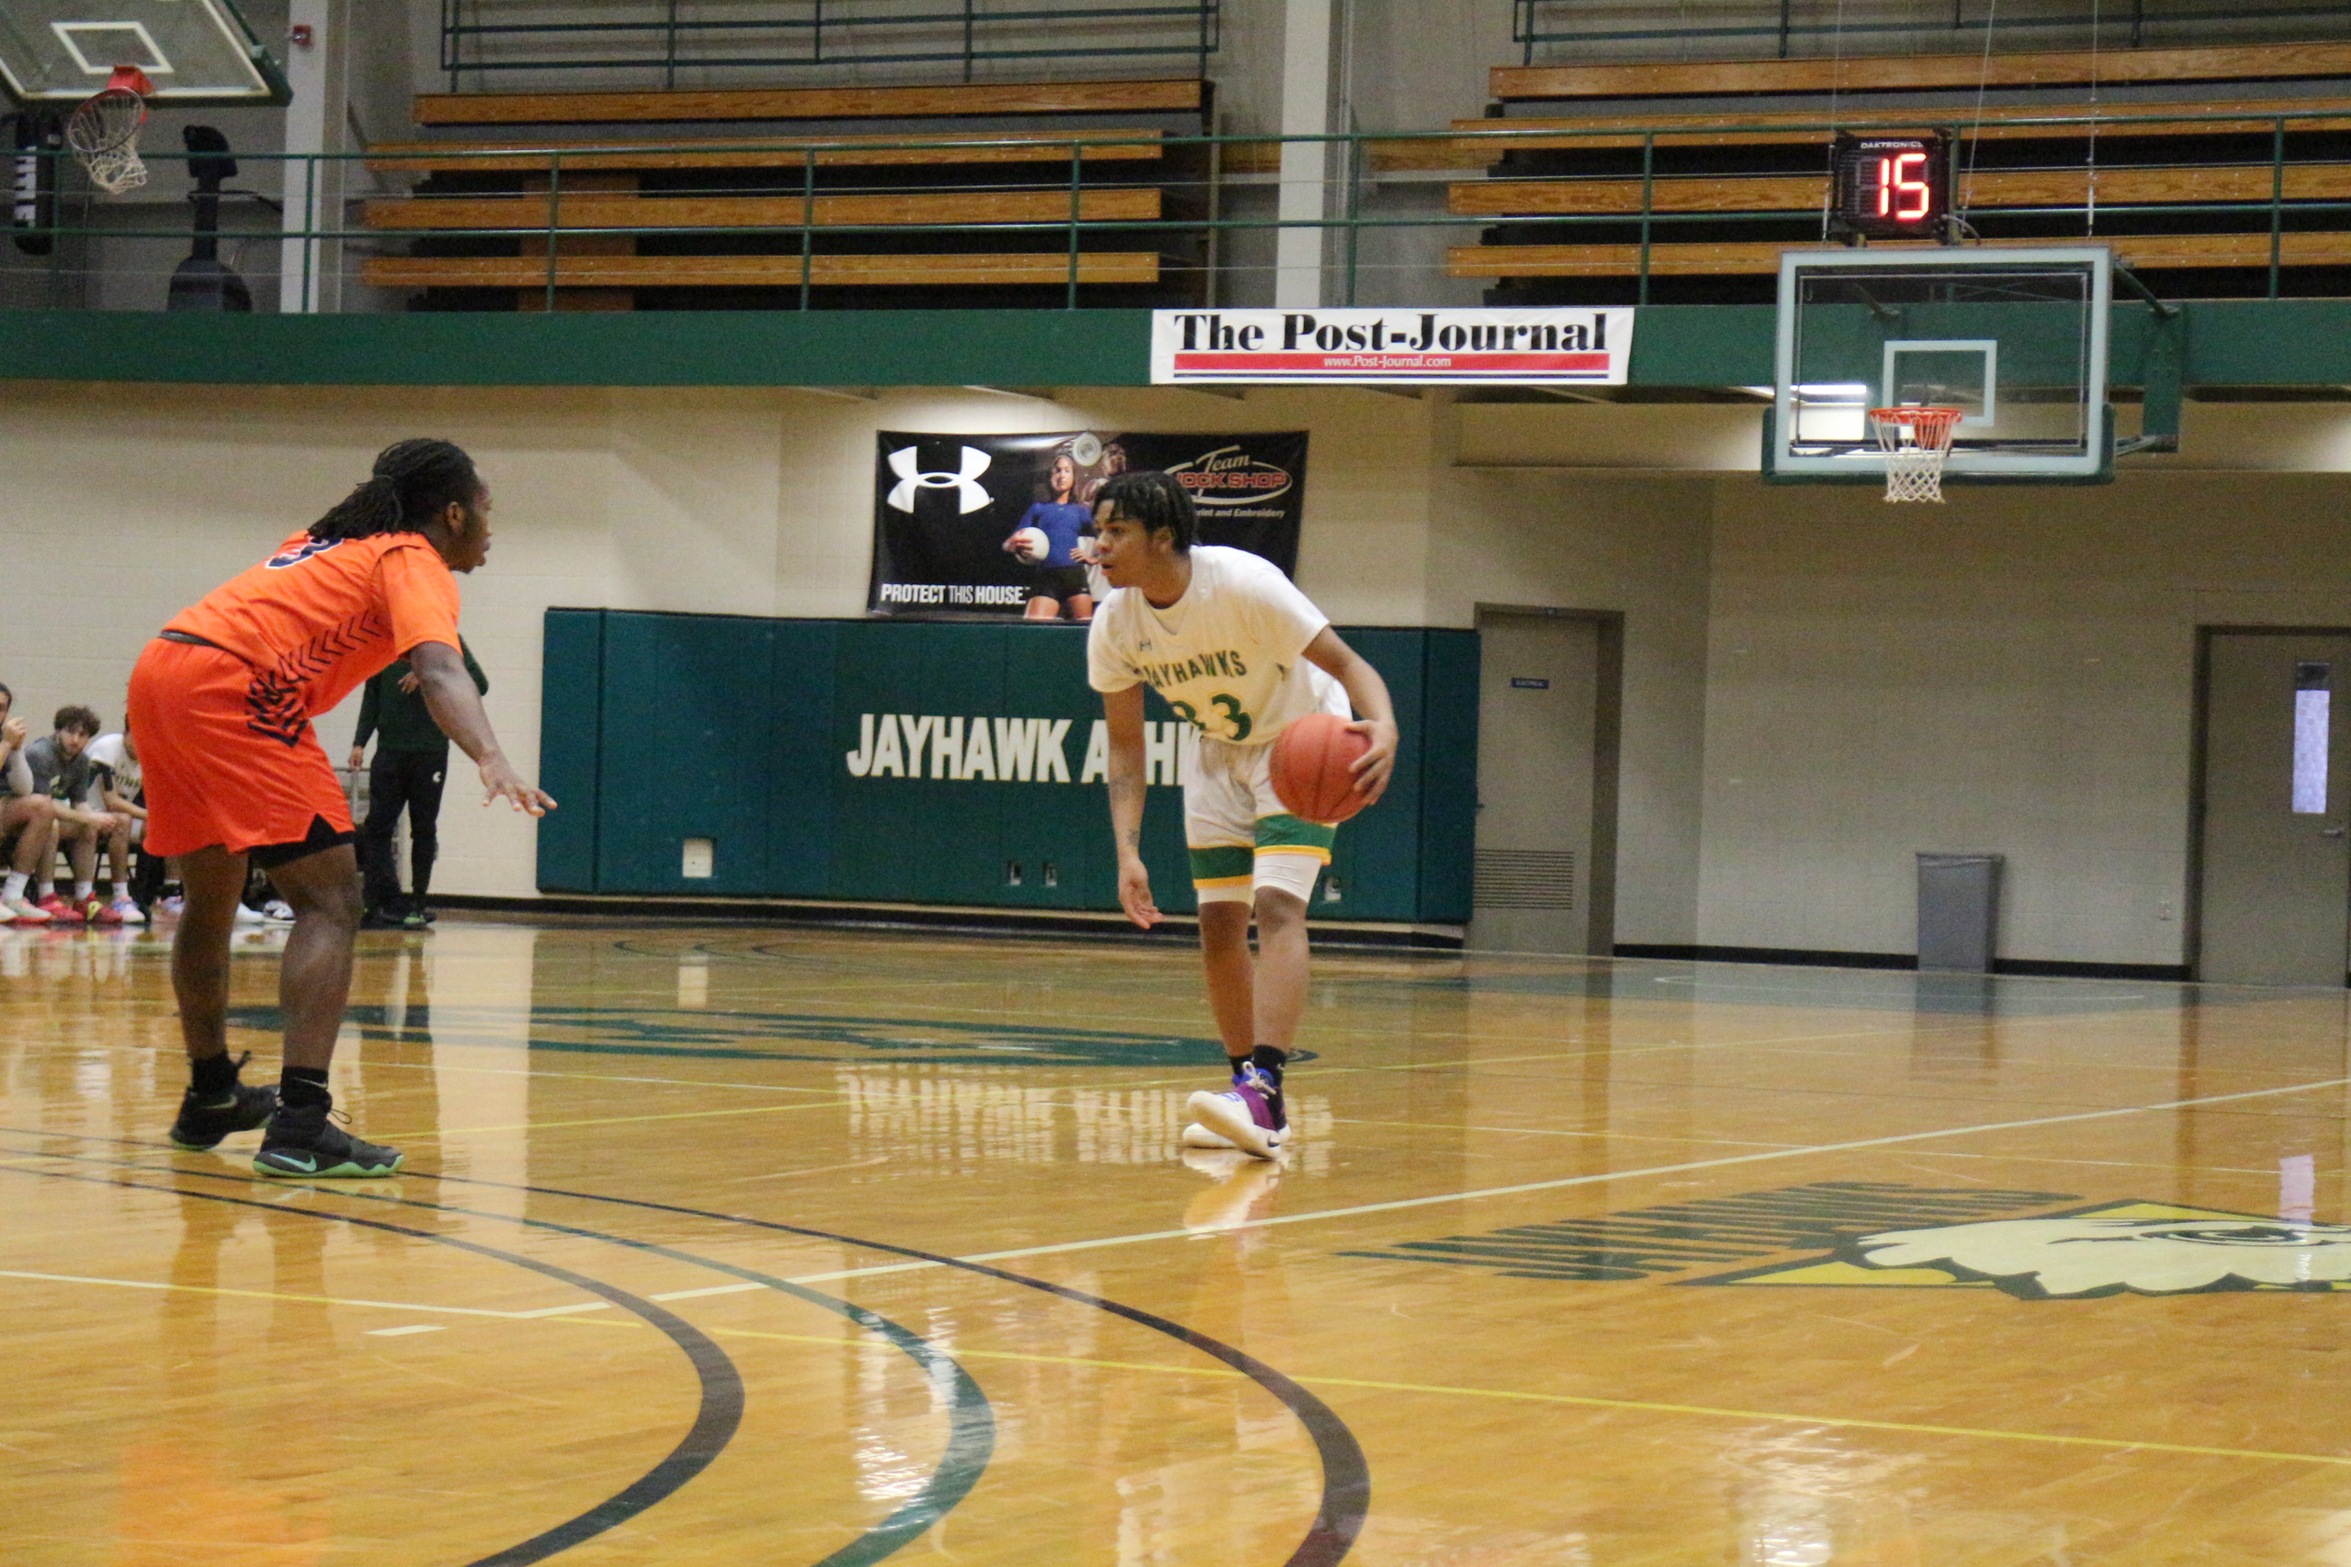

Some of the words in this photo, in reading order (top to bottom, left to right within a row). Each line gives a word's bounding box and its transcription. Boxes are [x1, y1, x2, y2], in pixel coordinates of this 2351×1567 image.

[1880, 153, 1930, 219] 15
[1173, 314, 1265, 352] The
[1281, 312, 1610, 351] Post-Journal
[1323, 355, 1452, 369] www.Post-Journal.com
[1195, 444, 1250, 475] Team
[1228, 471, 1288, 489] SHOP
[1214, 508, 1233, 518] and
[1233, 507, 1285, 519] Embroidery
[880, 583, 947, 604] PROTECT
[948, 584, 974, 604] THIS
[846, 713, 1072, 784] JAYHAWK
